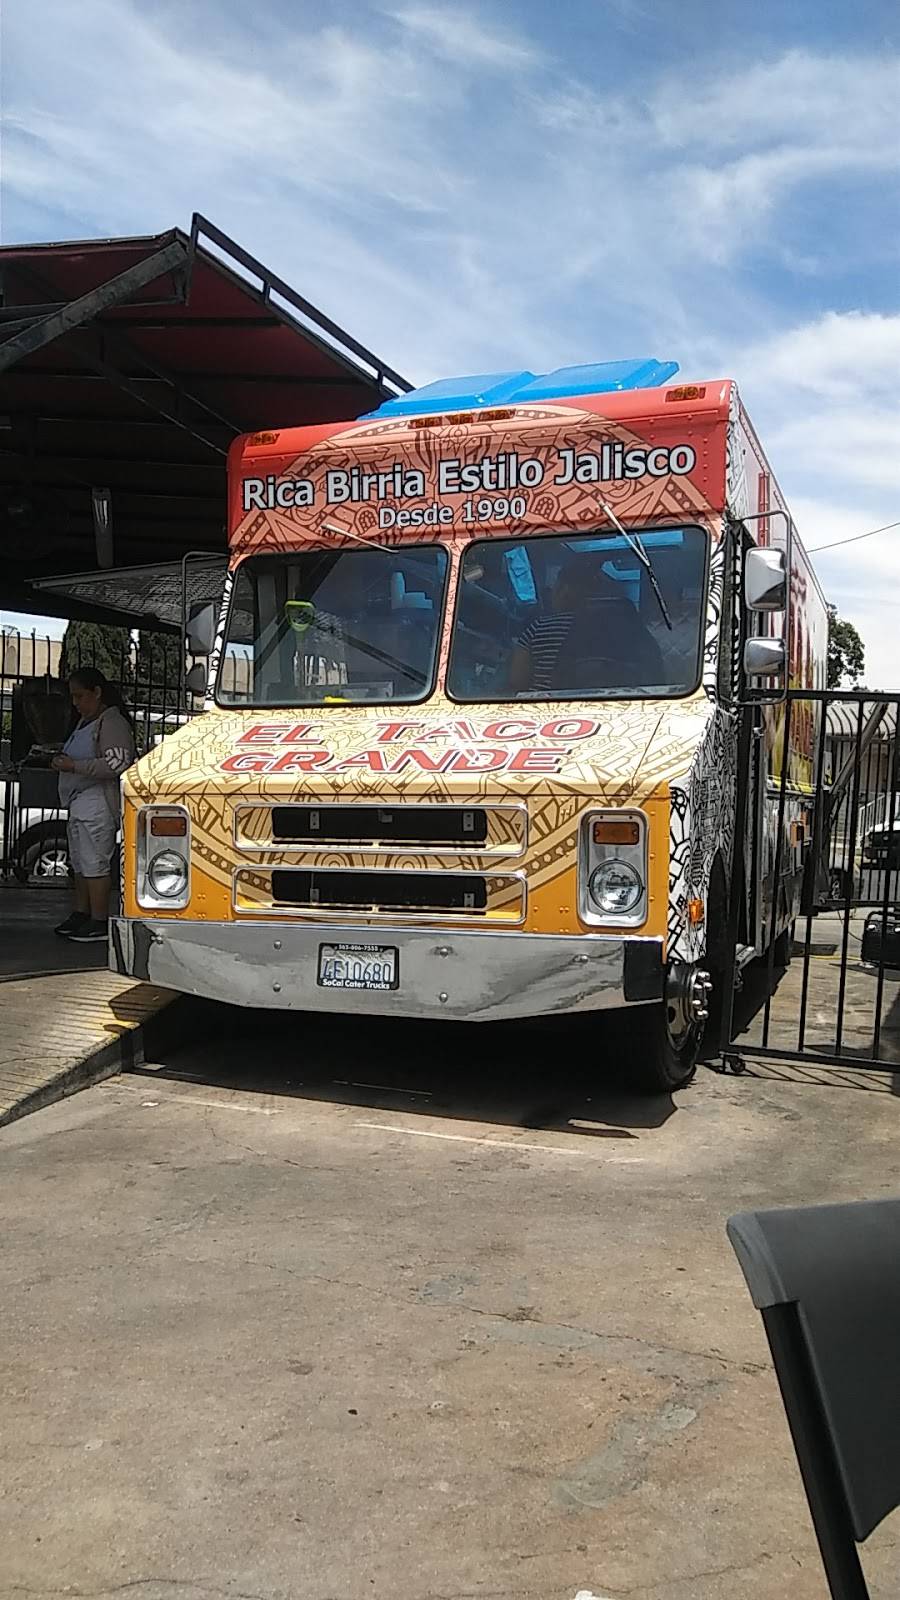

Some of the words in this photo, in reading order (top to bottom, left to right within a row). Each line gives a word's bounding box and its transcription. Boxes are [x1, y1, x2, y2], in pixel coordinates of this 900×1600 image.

[241, 476, 316, 511] Rica
[326, 464, 425, 504] Birria
[437, 452, 544, 495] Estilo
[554, 443, 696, 486] Jalisco
[378, 505, 453, 529] Desde
[461, 496, 526, 524] 1990
[235, 723, 325, 745] EL
[375, 718, 602, 743] TACO
[219, 746, 573, 774] GRANDE
[322, 979, 344, 987] SoCal
[344, 980, 365, 988] Cater
[366, 981, 390, 989] Trucks
